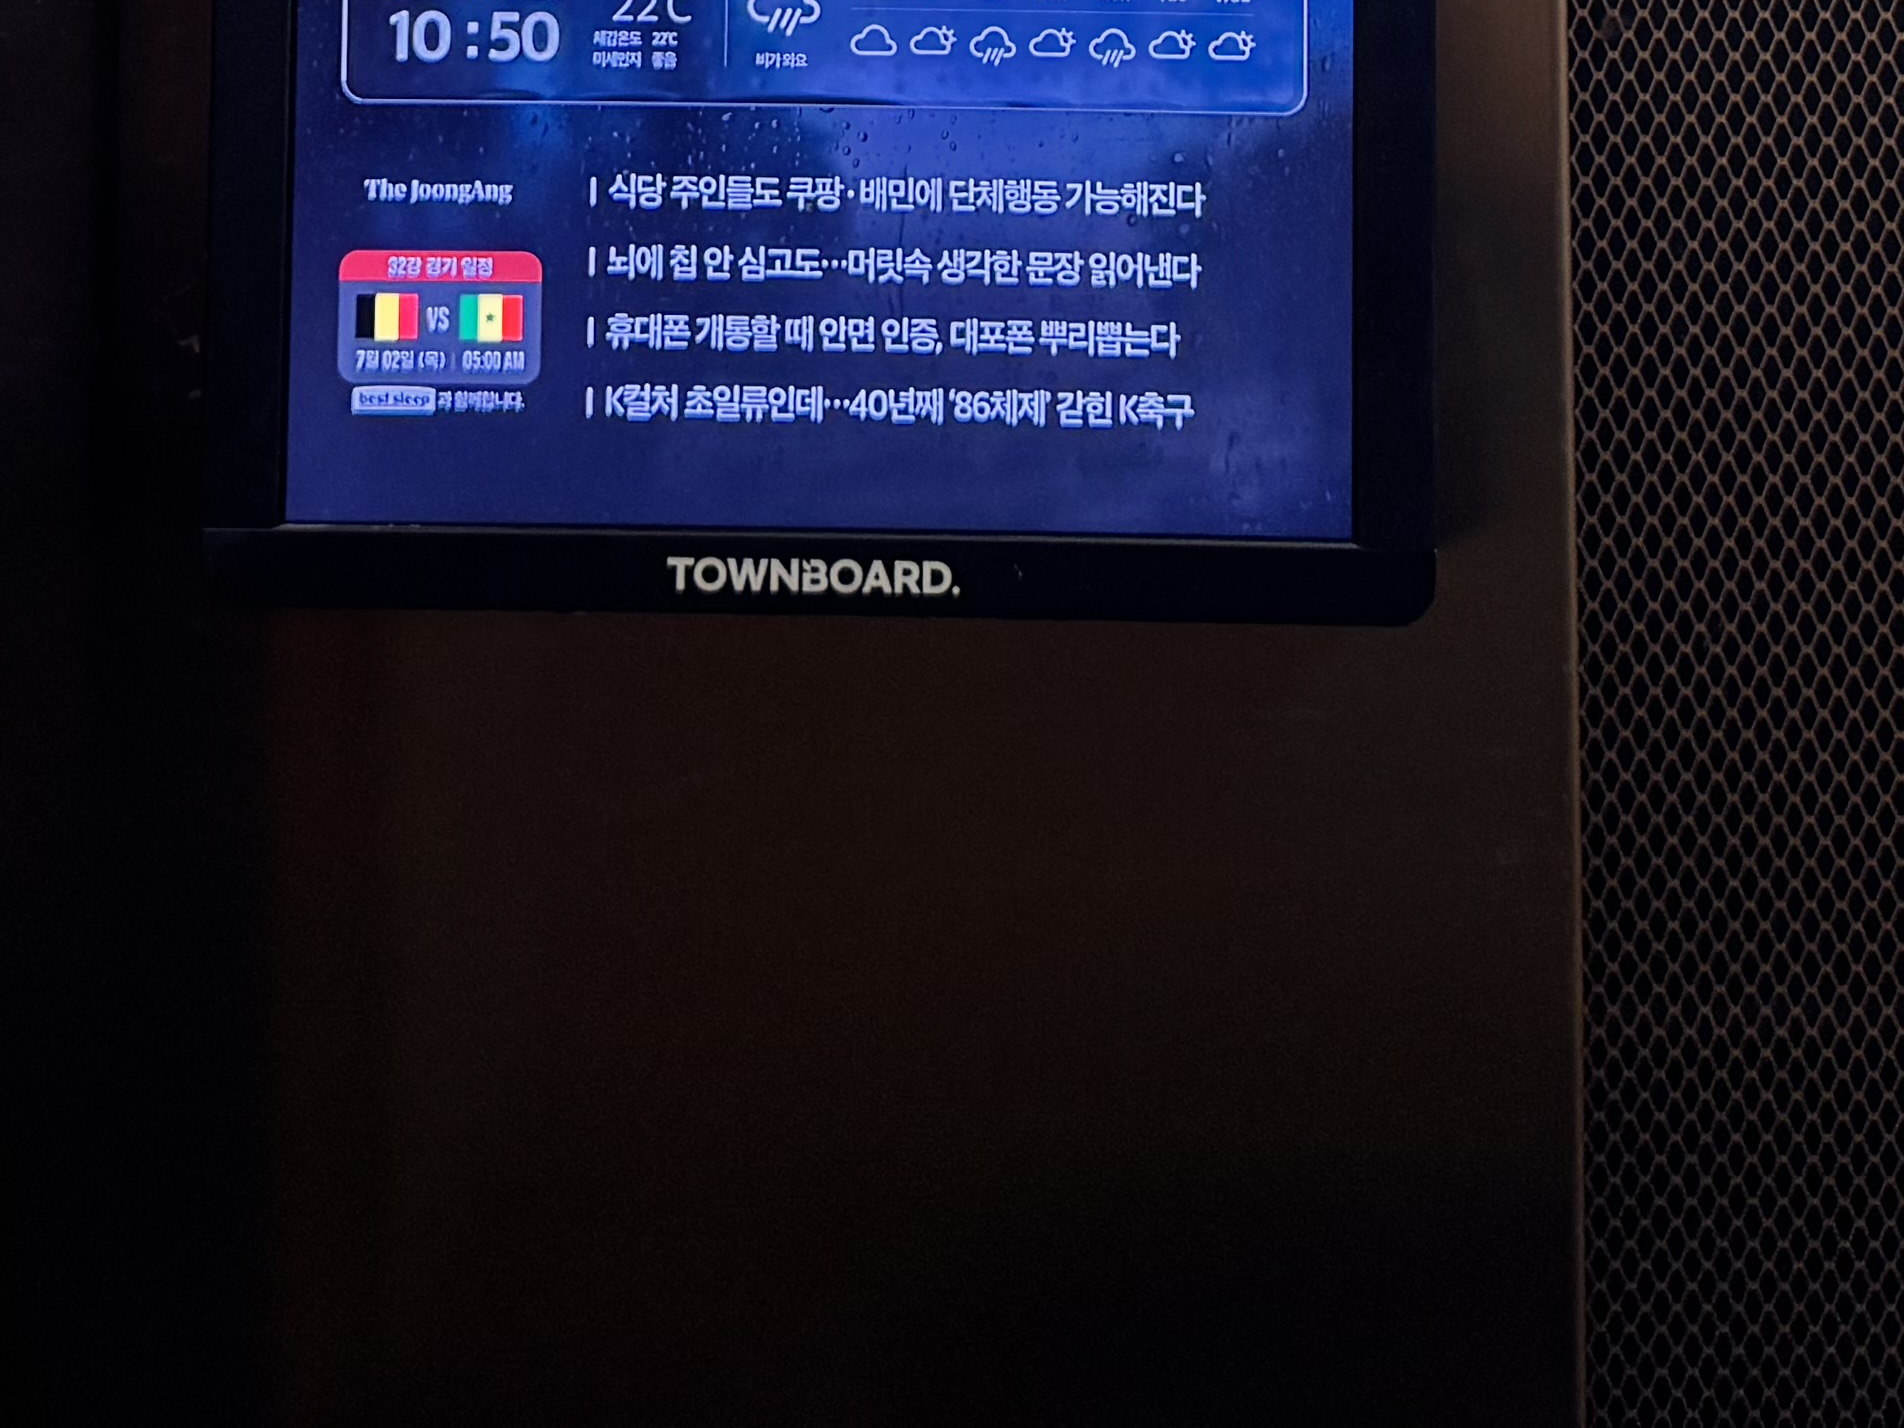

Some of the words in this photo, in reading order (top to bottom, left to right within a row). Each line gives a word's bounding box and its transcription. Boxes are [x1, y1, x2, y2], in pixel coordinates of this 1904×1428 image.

[363, 177, 408, 202] The
[410, 178, 514, 206] JoongAng
[607, 172, 667, 212] 식당
[669, 173, 783, 213] 주인들도
[948, 177, 1061, 216] 단체행동
[1064, 179, 1207, 219] 가능해진다
[606, 243, 664, 282] 뇌에
[669, 244, 697, 282] 칩
[702, 244, 734, 282] 안
[936, 248, 1022, 287] 생각한
[1025, 250, 1085, 288] 문장
[1088, 251, 1203, 290] 읽어낸다
[425, 306, 450, 334] VS
[605, 311, 692, 352] 휴대폰
[694, 312, 782, 353] 개통할
[783, 314, 815, 354] 때
[817, 314, 877, 355] 안면
[879, 316, 944, 356] 인증,
[948, 317, 1036, 357] 대포폰
[1038, 319, 1182, 360] 뿌리뽑는다
[502, 350, 526, 372] AM
[604, 382, 679, 422] K컬처
[1054, 390, 1114, 429] 갇힌
[1118, 391, 1196, 431] K축구
